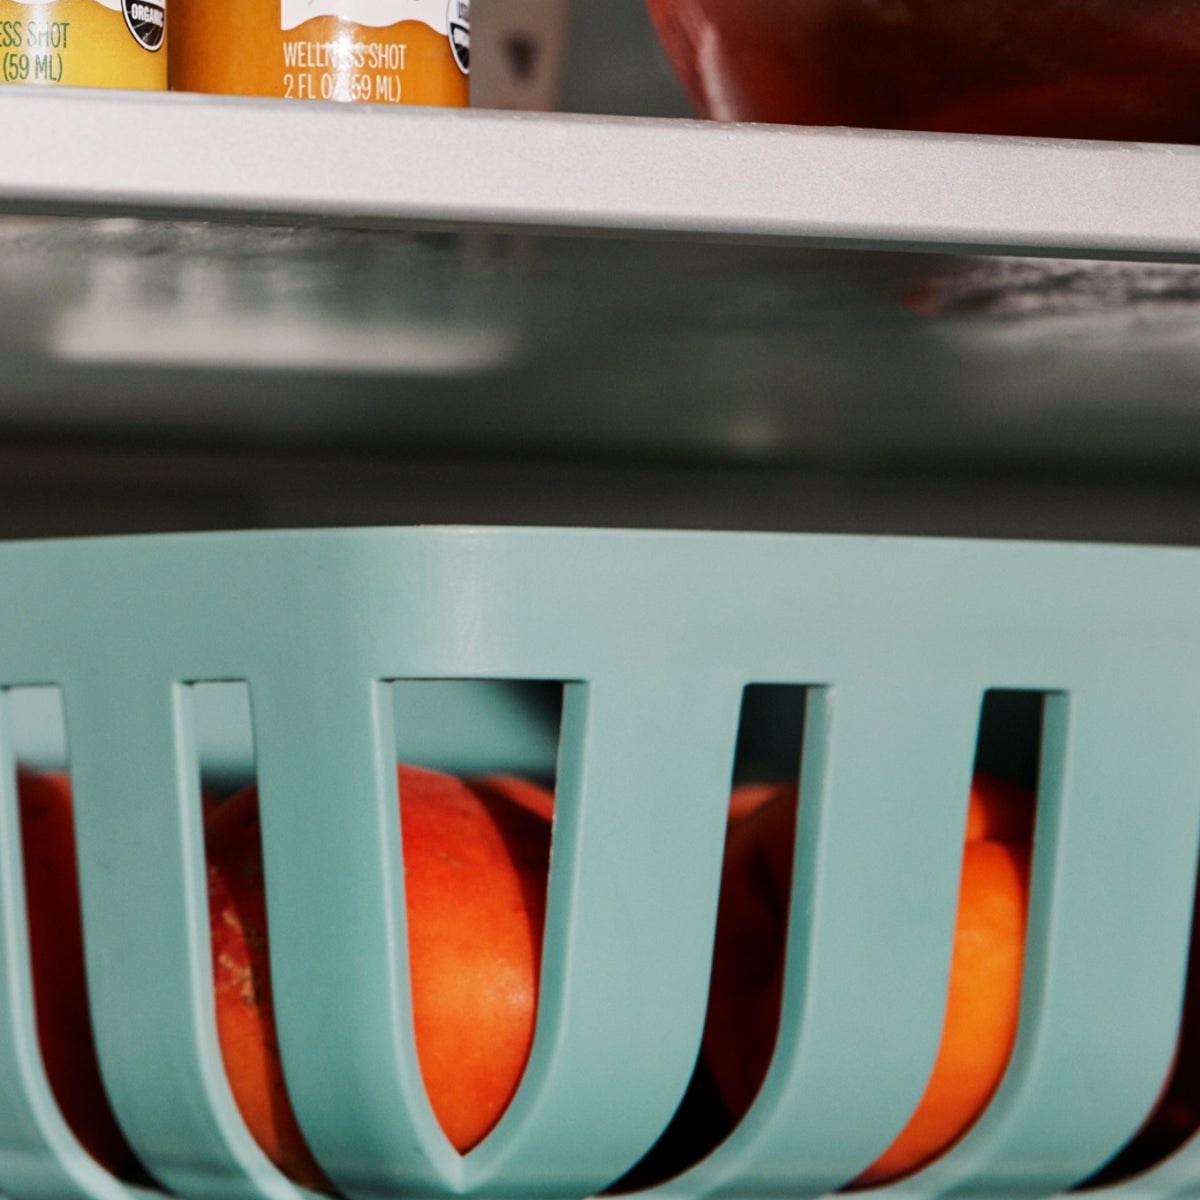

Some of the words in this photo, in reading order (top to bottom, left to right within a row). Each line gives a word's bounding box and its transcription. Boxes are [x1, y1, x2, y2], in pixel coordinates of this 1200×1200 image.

[27, 21, 70, 49] SHOT
[3, 52, 30, 82] (59
[35, 53, 63, 83] ML)
[368, 42, 407, 70] SHOT
[283, 73, 294, 99] 2
[299, 73, 316, 99] FL
[376, 74, 402, 103] ML)
